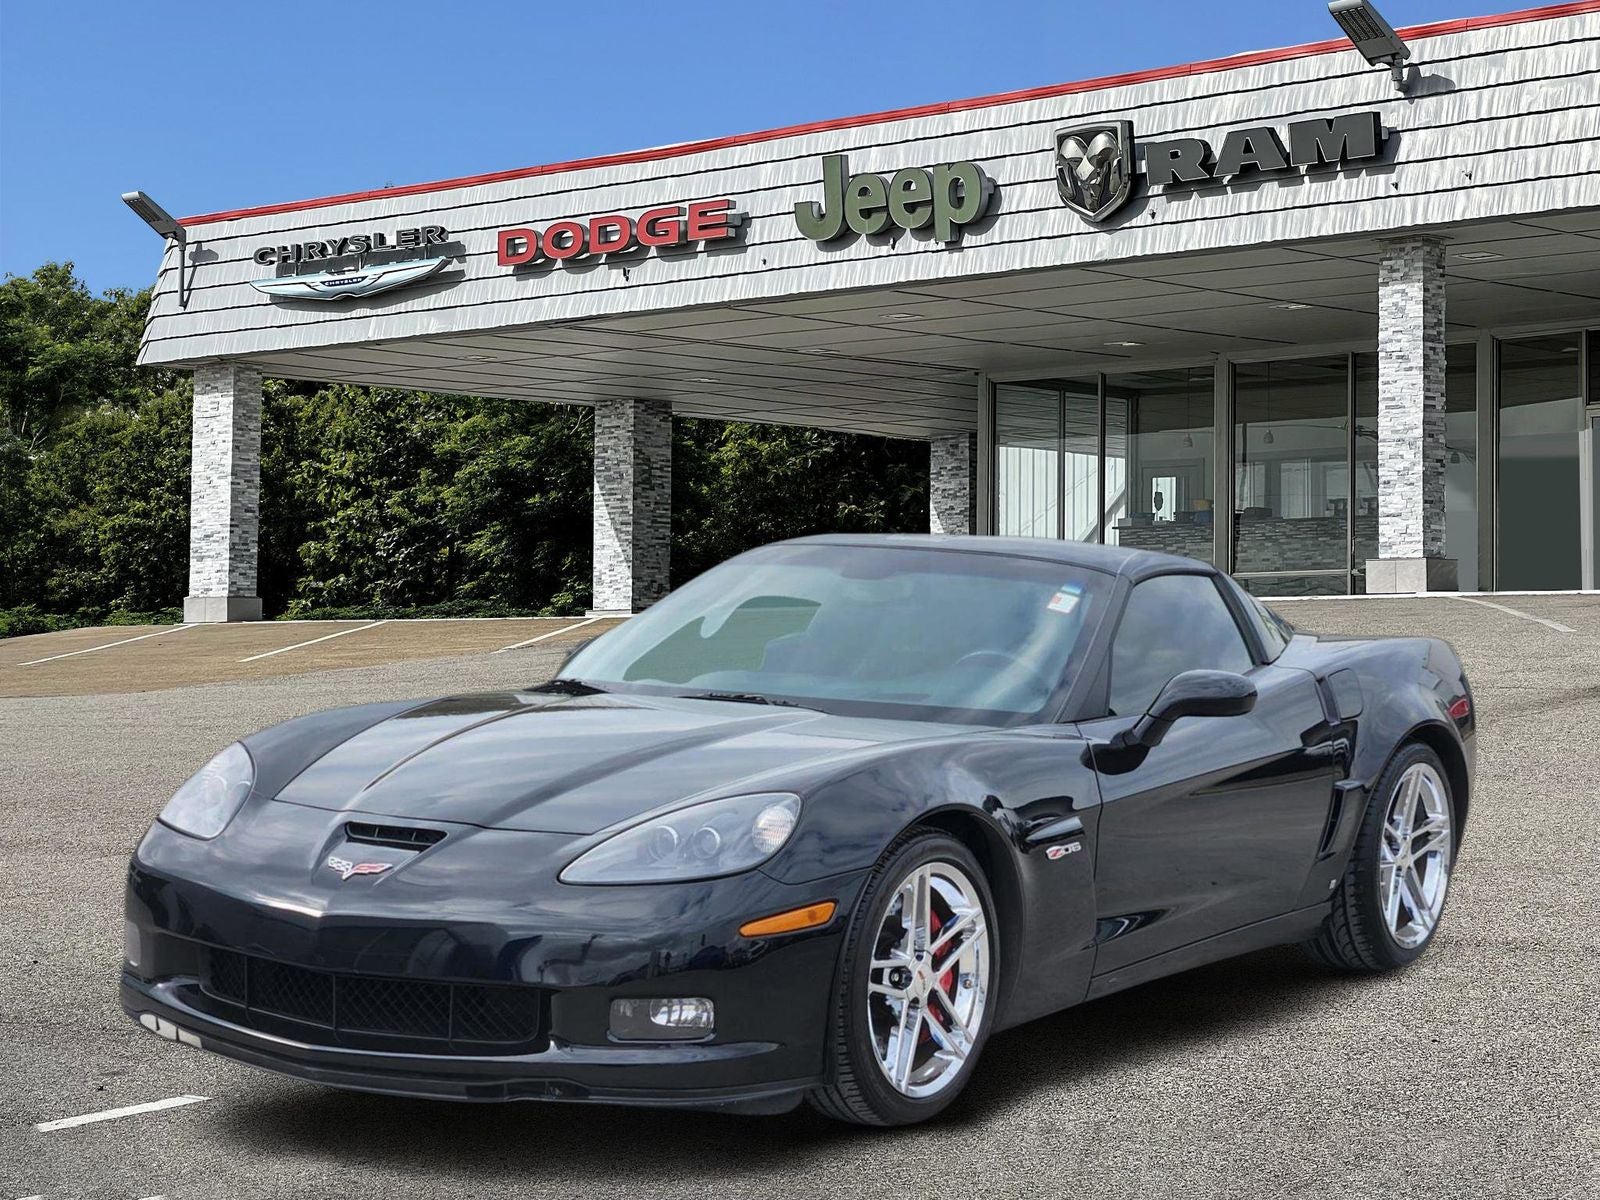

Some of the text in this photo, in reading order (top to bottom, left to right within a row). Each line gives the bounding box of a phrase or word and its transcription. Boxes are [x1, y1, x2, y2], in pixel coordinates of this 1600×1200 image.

[1145, 111, 1379, 186] RAM
[794, 154, 984, 242] Jeep
[252, 225, 448, 266] CHRYSLER
[498, 200, 733, 266] DODGE
[324, 277, 363, 286] CHRYSLER
